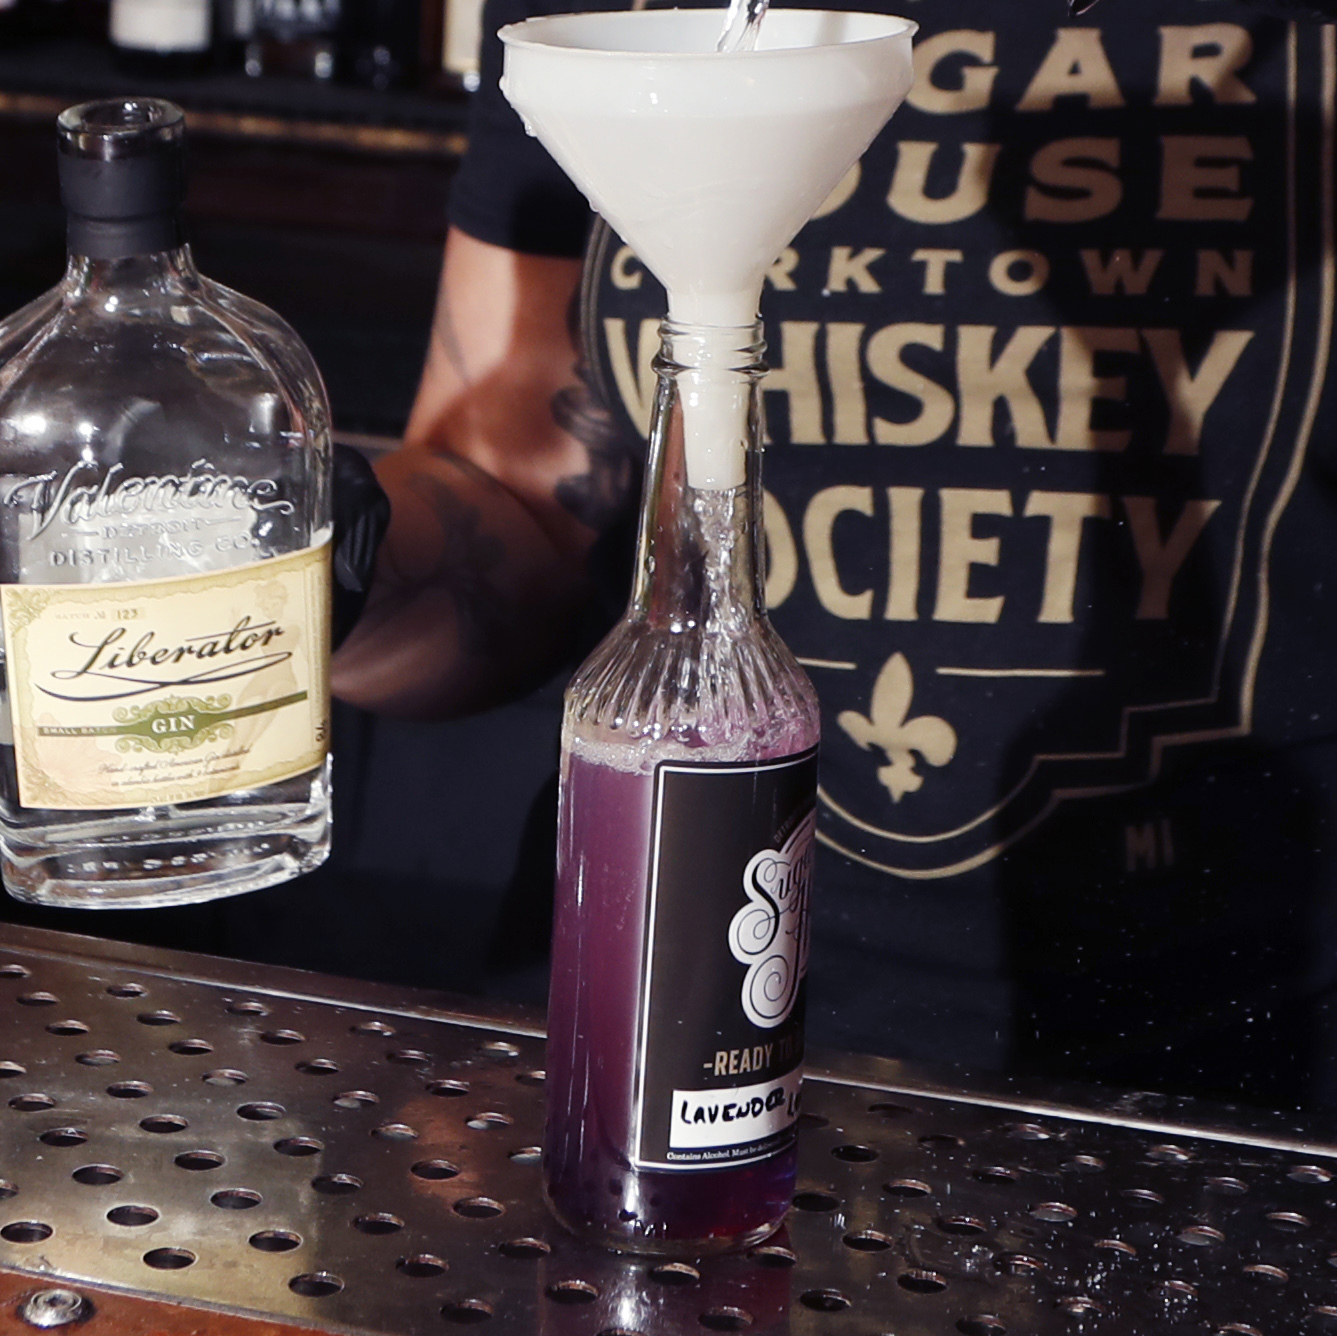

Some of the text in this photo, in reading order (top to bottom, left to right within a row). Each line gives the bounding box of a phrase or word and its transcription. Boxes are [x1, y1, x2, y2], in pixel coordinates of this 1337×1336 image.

[904, 23, 1256, 115] GAR
[610, 245, 1254, 296] CRKTOWN
[3, 459, 294, 540] Valentine
[50, 540, 204, 567] DISTILLING
[117, 609, 138, 620] 123
[51, 615, 286, 679] Liberator
[43, 727, 77, 735] SMALL
[152, 715, 195, 734] GIN
[666, 1152, 701, 1161] Contains
